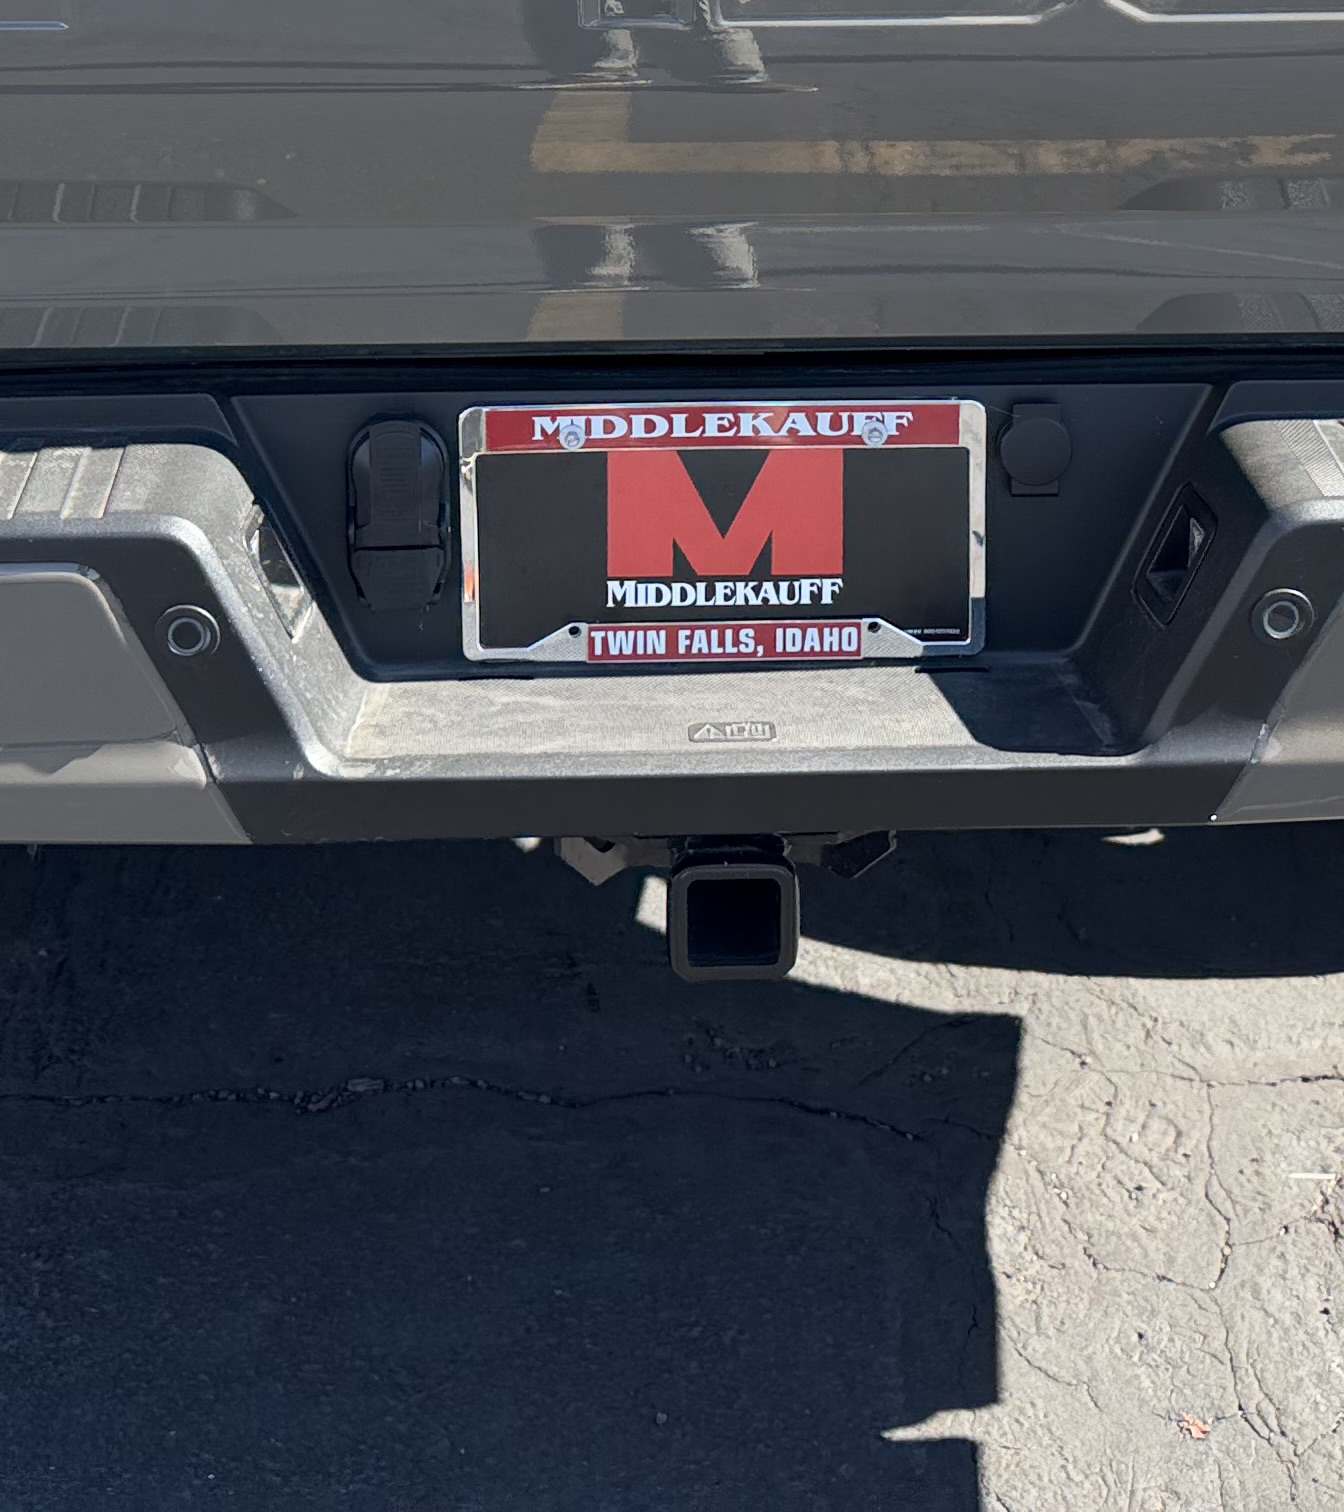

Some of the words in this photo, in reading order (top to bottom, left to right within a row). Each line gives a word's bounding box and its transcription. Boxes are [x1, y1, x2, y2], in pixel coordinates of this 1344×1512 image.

[532, 411, 914, 441] MIDDLEKAUFF
[606, 449, 844, 577] M
[606, 578, 844, 608] MIDDLEKAUFF
[590, 629, 667, 656] TWIN
[677, 627, 764, 657] FALLS,
[775, 625, 858, 653] IDAHO
